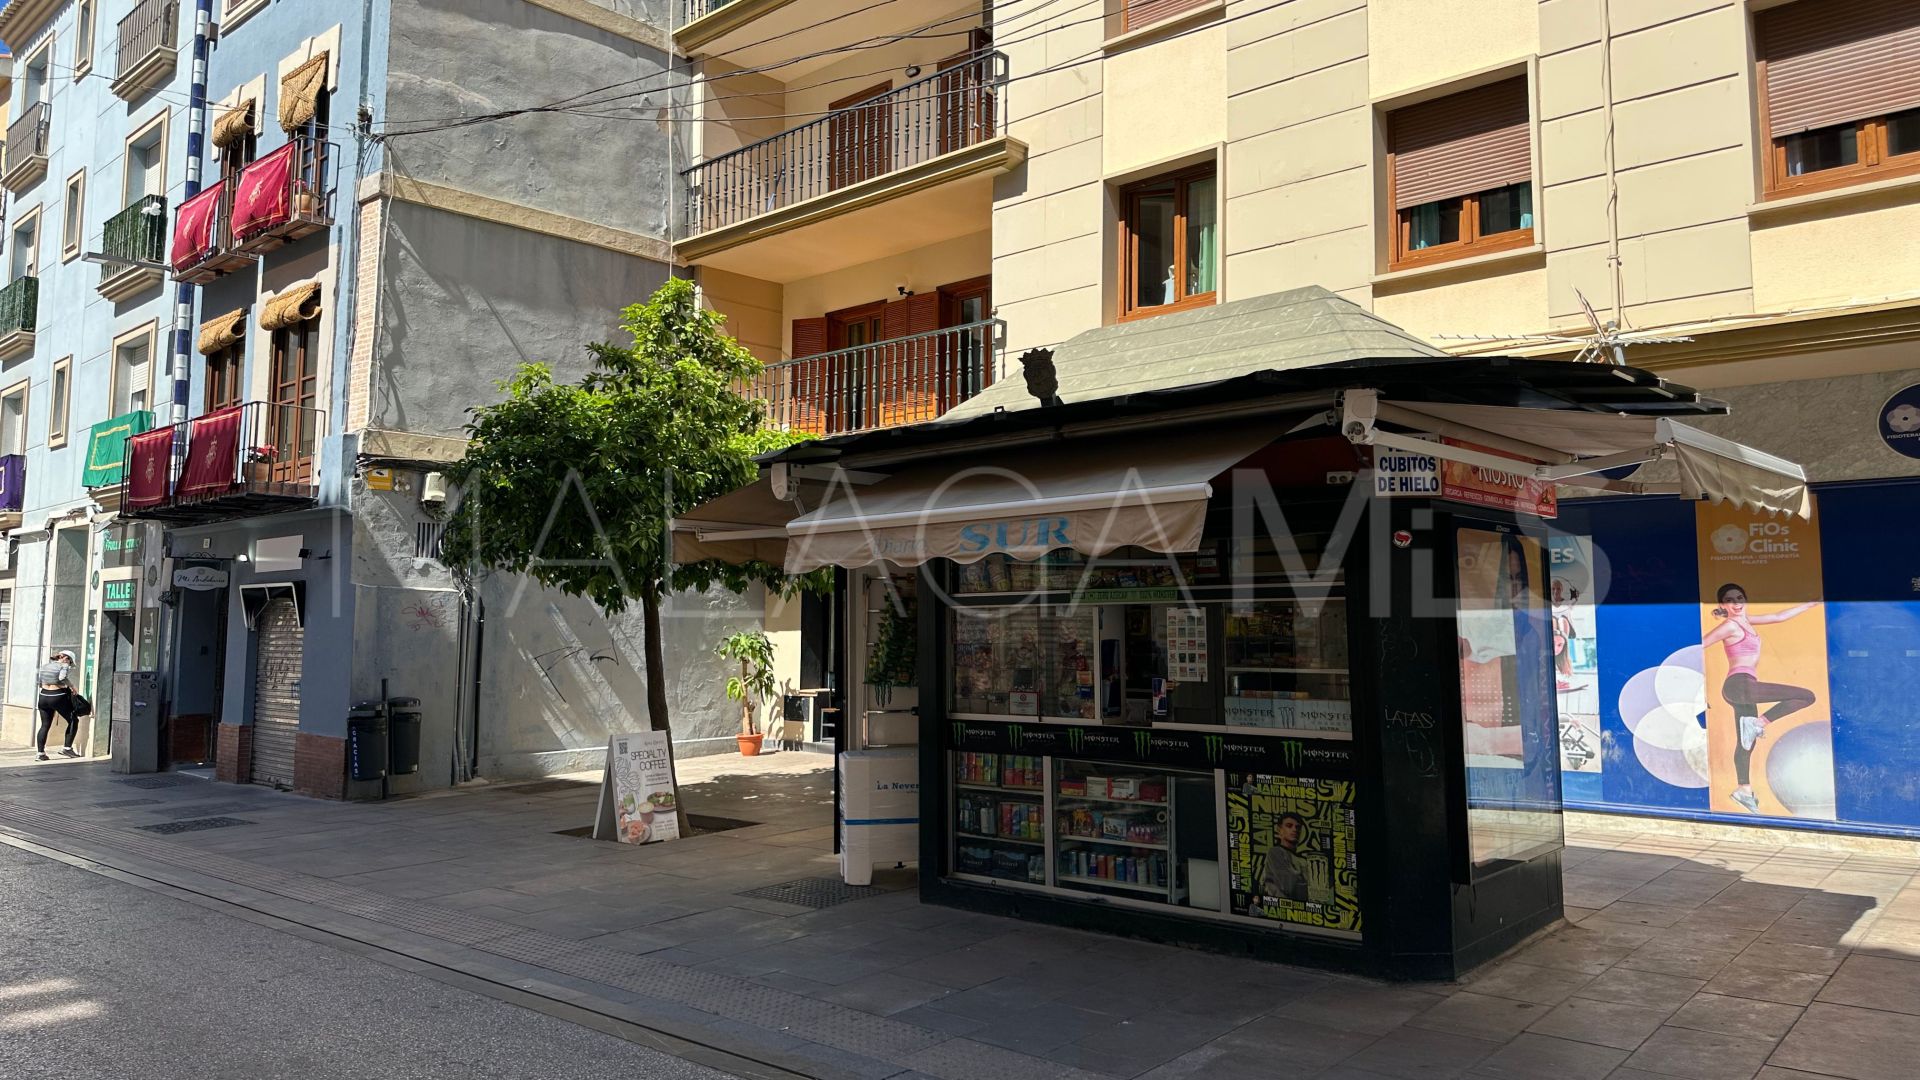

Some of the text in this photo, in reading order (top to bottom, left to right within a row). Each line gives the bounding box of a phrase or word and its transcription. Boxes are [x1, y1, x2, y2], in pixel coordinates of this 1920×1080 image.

[1380, 456, 1436, 472] CUBITOS
[1378, 476, 1439, 492] DE HIELO
[959, 516, 1073, 554] SUR
[1749, 521, 1790, 537] FiOs
[1749, 538, 1799, 553] Clinic
[1551, 547, 1575, 565] ES
[106, 582, 136, 599] TALLER
[1300, 711, 1351, 721] MONSTE
[351, 730, 360, 775] GRACIAS
[630, 748, 667, 761] SPECIALTY
[1223, 743, 1266, 753] MONSTER
[1302, 749, 1350, 760] MONSTER
[639, 759, 668, 772] COFFEE
[892, 781, 921, 790] Never
